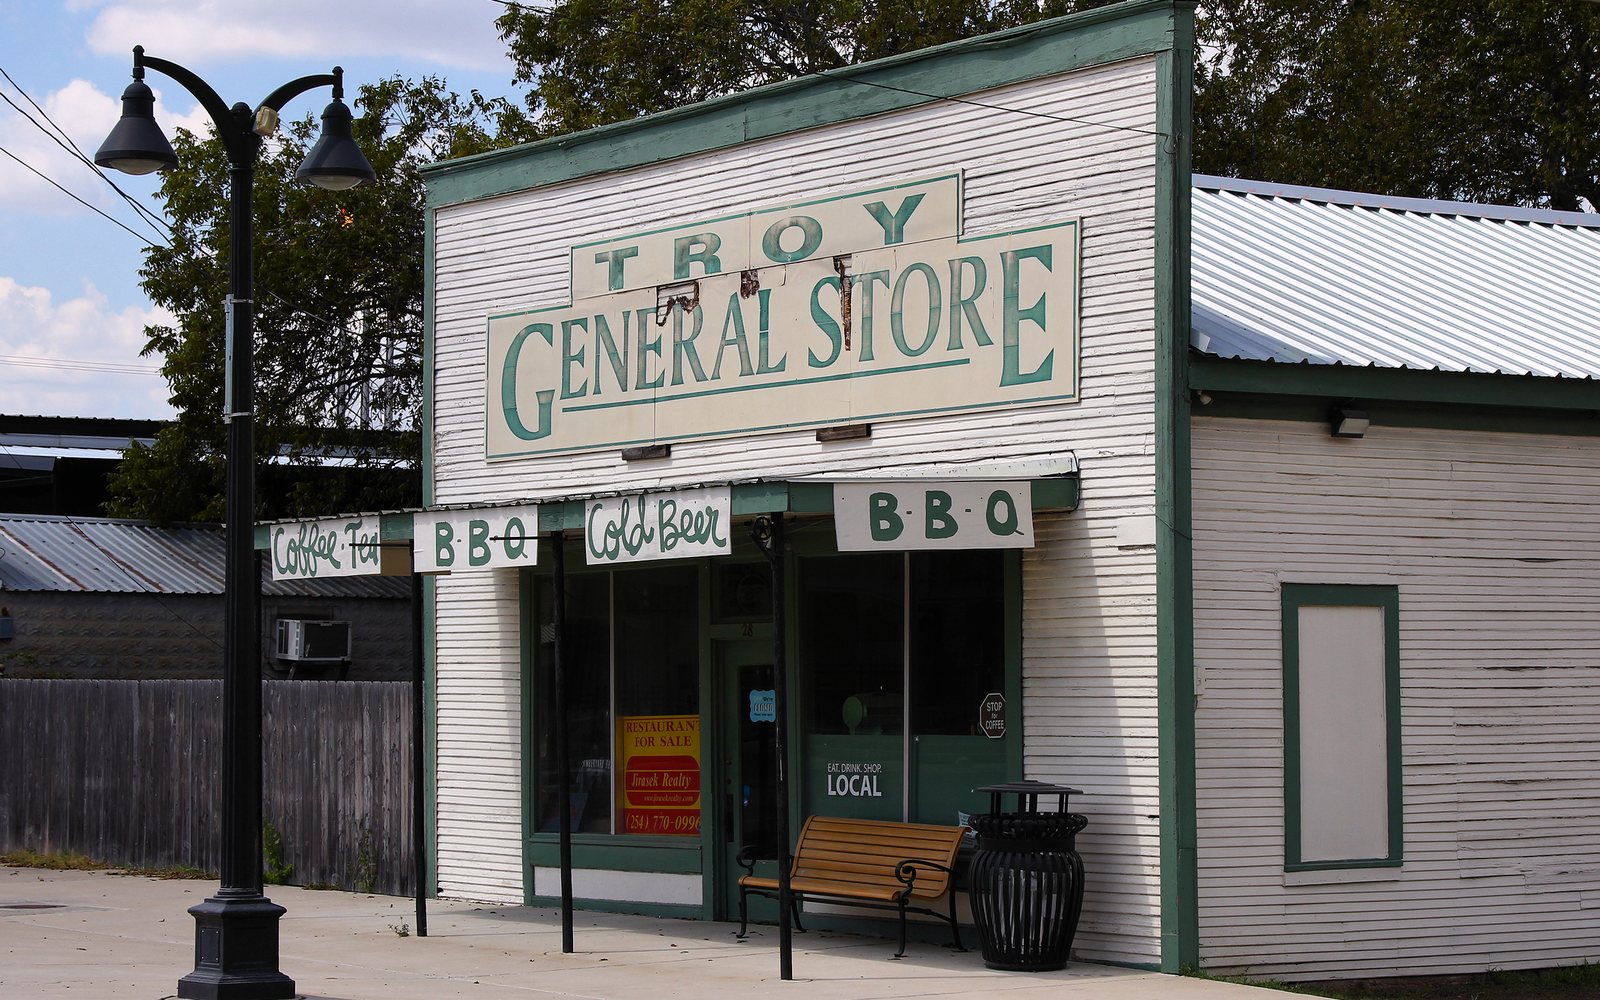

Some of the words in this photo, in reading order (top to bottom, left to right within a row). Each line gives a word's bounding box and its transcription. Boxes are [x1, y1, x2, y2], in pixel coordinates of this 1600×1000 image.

[594, 193, 925, 290] TROY
[503, 289, 787, 440] GENERAL
[807, 244, 1054, 388] STORE
[587, 494, 654, 560] Cold
[659, 499, 727, 553] Beer
[274, 522, 341, 577] Coffee
[344, 519, 379, 566] Tea
[986, 702, 1003, 712] STOP
[985, 720, 1004, 730] COFFEE
[635, 737, 656, 747] FOR
[660, 735, 692, 747] SALE
[827, 763, 841, 773] EAT.
[841, 763, 863, 773] DRINK.
[631, 772, 659, 787] Jirasek
[662, 772, 692, 789] Realty
[827, 774, 882, 797] LOCAL
[626, 814, 649, 831] (254)
